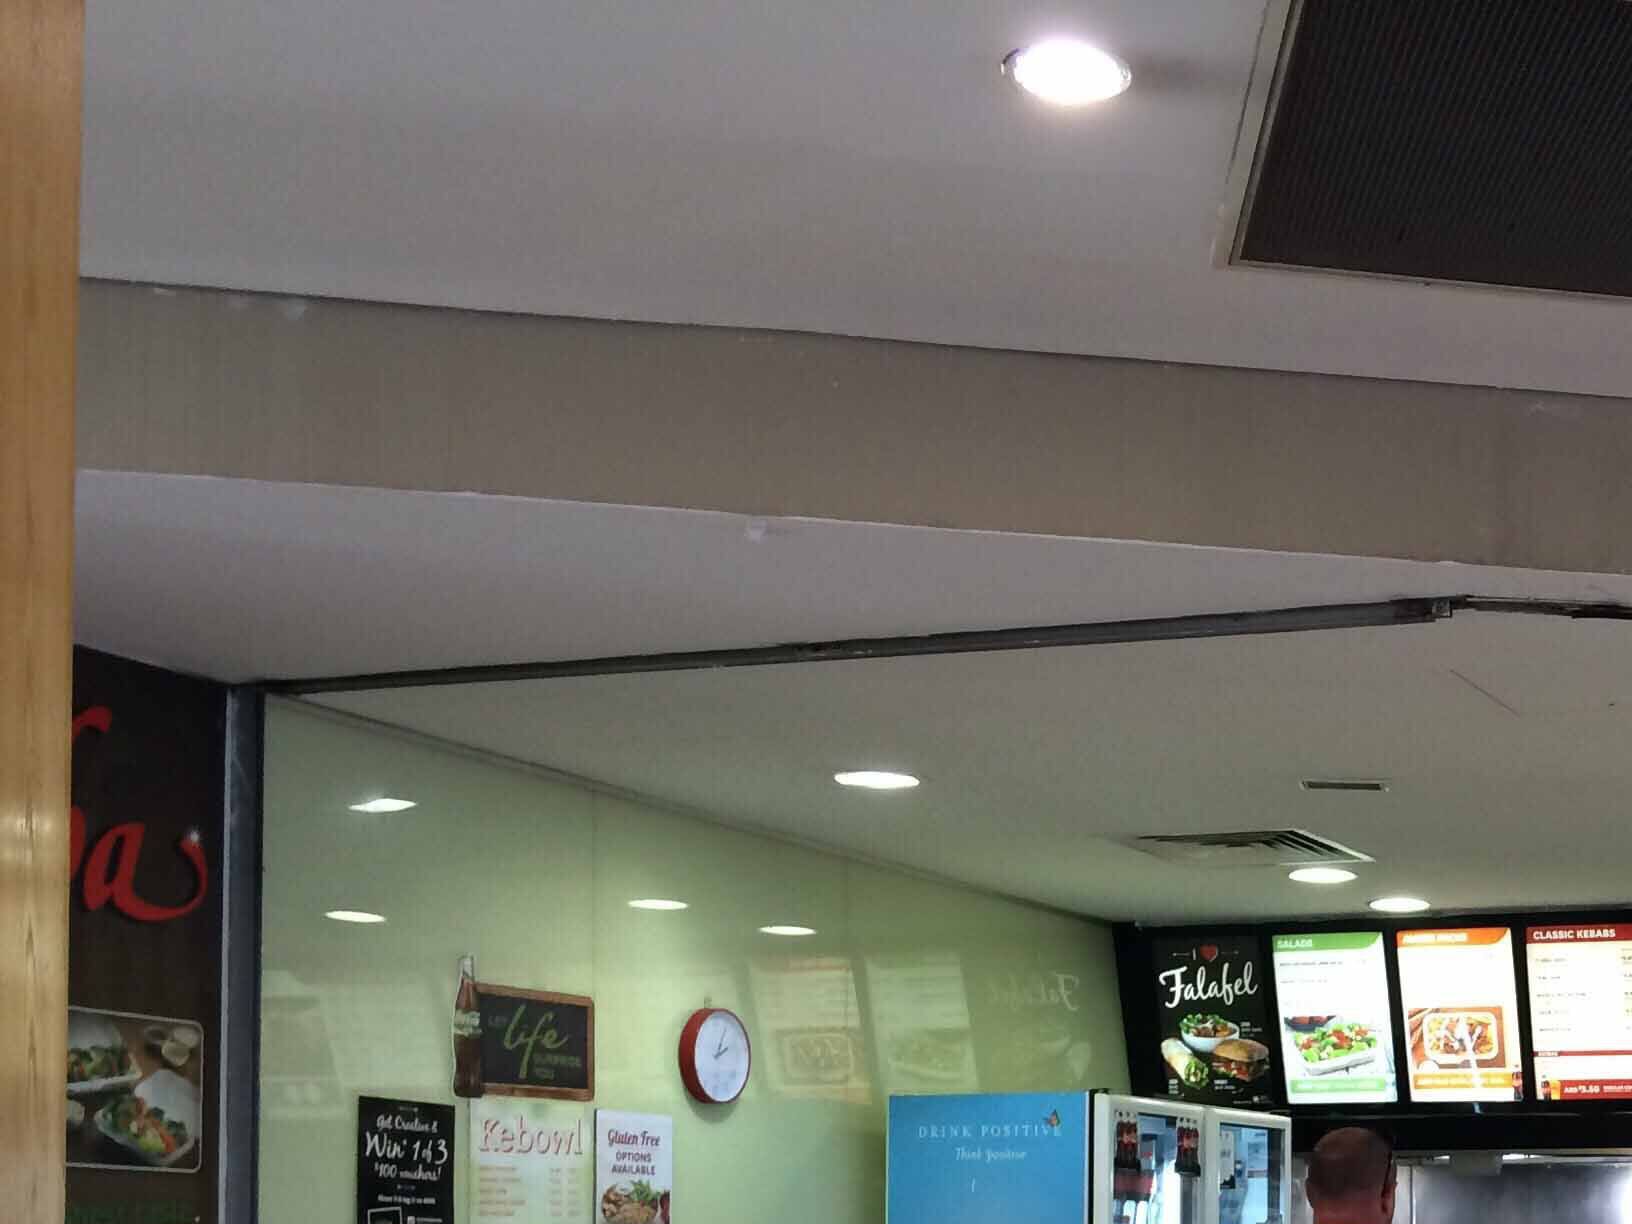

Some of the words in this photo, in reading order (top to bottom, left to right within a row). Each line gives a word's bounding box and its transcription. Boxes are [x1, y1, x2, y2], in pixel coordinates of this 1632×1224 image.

[1533, 929, 1574, 940] CLASSIC
[1576, 928, 1616, 939] KEBABS
[1159, 961, 1258, 1008] Falafel
[480, 1115, 583, 1155] Kebowl
[607, 1128, 638, 1148] Gluten
[640, 1130, 660, 1147] Free
[919, 1124, 971, 1138] DRINK
[981, 1123, 1062, 1137] POSITIVE
[435, 1138, 448, 1165] 3
[615, 1151, 652, 1163] OPTIONS
[611, 1164, 655, 1176] AVAILABLE
